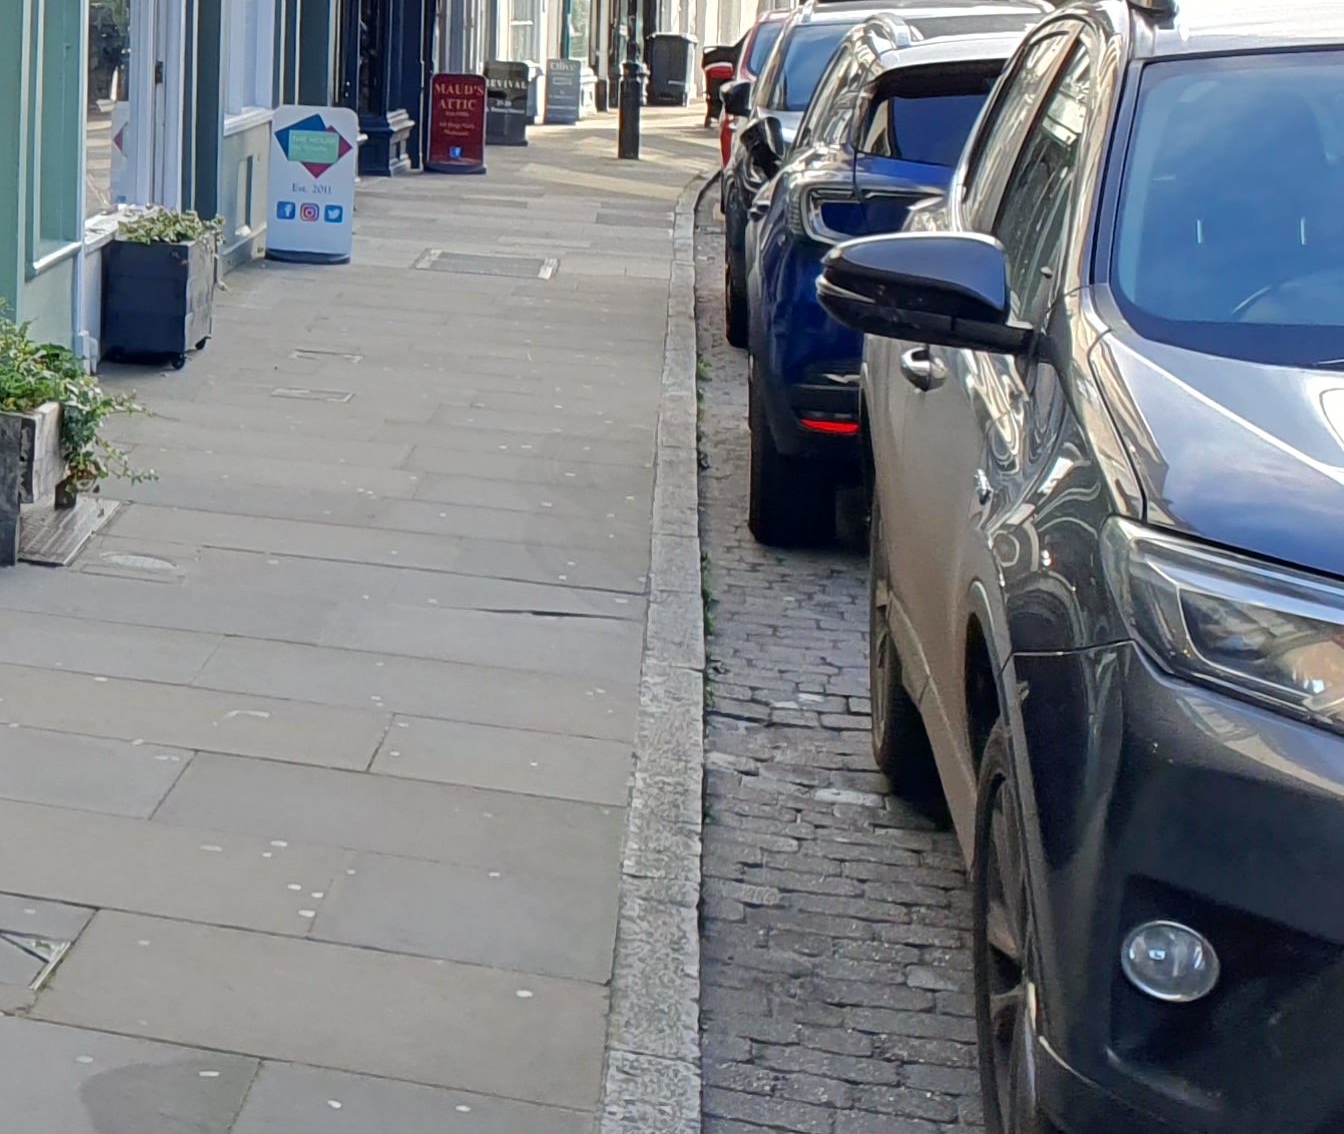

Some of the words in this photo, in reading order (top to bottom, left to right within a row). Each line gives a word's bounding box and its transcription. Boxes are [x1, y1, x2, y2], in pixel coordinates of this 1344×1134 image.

[434, 83, 484, 96] MAUD'S
[439, 99, 477, 111] ATTIC
[292, 182, 309, 193] Est.
[312, 184, 332, 195] 2011
